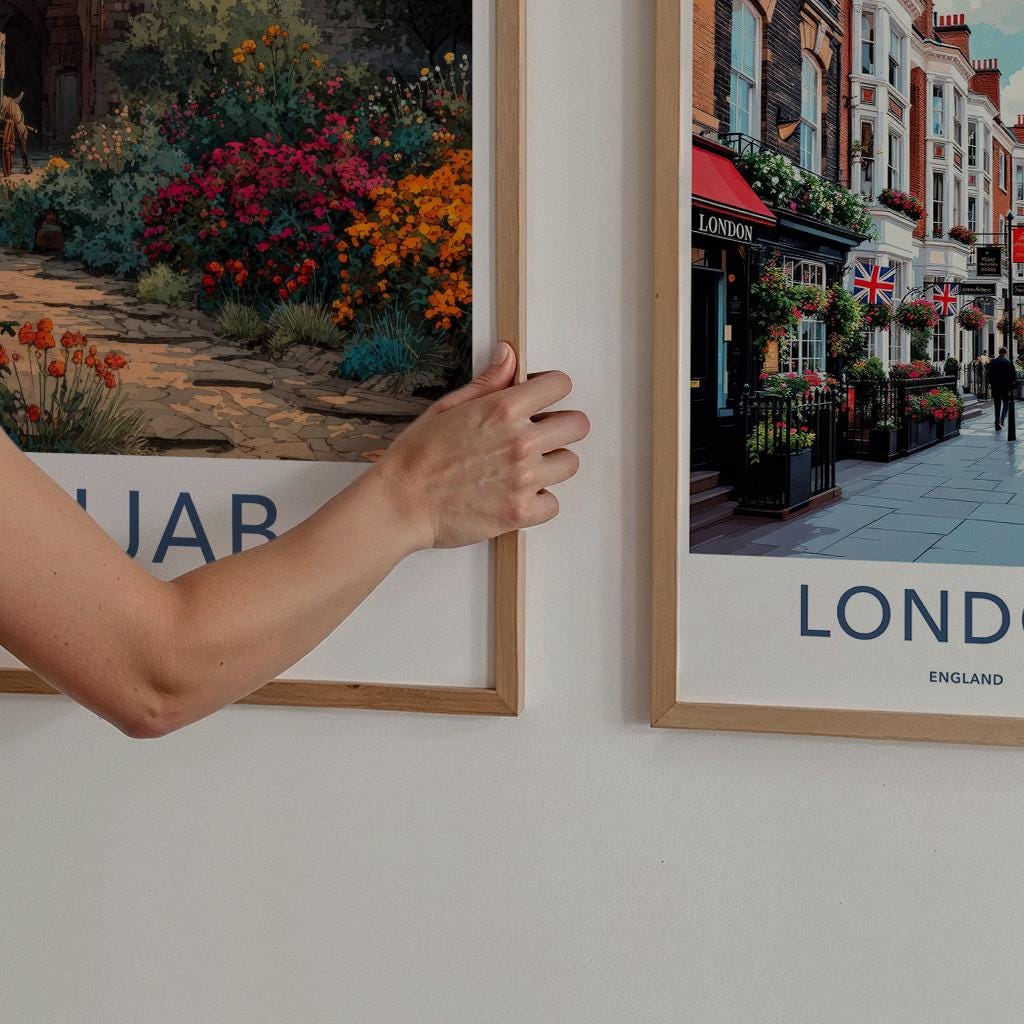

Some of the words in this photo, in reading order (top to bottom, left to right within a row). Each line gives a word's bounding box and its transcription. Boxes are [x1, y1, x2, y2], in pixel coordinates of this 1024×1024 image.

[698, 213, 753, 242] LONDON
[800, 584, 1024, 645] LOND
[929, 670, 1004, 686] ENGLAND
